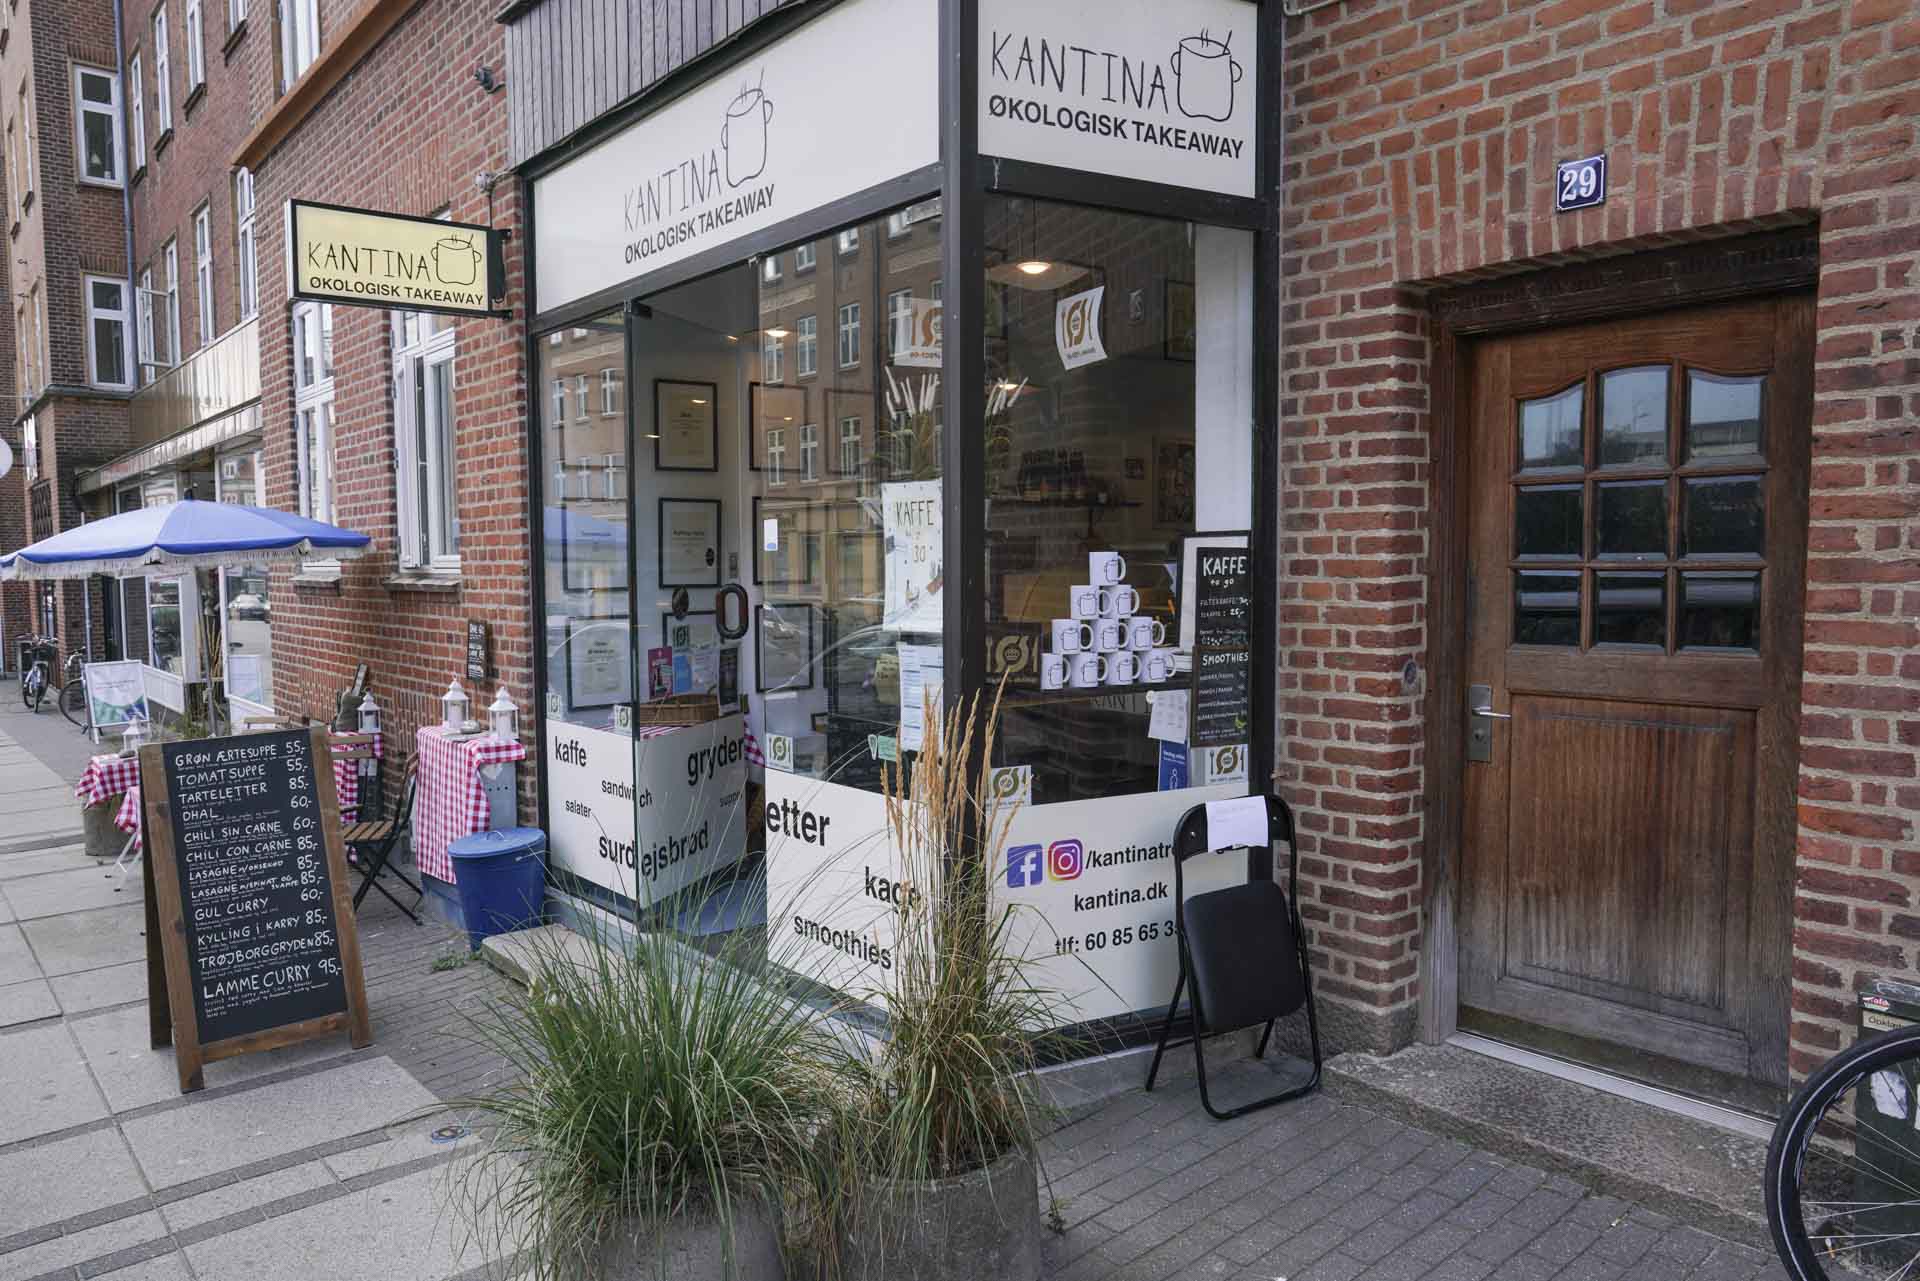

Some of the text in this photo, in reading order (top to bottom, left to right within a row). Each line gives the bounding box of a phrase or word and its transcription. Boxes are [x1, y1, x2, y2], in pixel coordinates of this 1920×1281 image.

[992, 31, 1168, 114] KANTINA
[988, 94, 1244, 160] ØKOLOGISK TAKEAWAY
[624, 149, 722, 233] KANTINA
[1561, 166, 1597, 202] 29
[624, 183, 775, 264] ØKOLOGISK TAKEAWAY
[308, 241, 431, 282] KANTINA
[404, 286, 484, 306] TAKEAWAY
[896, 499, 935, 528] KAFFE
[913, 544, 927, 564] 30
[1203, 555, 1248, 577] KAFFE
[1202, 651, 1249, 667] SMOOTHIES
[175, 753, 211, 767] GRØN
[216, 744, 278, 762] ÆRTESUPPE
[554, 735, 745, 787] kaffe gryder
[178, 782, 268, 804] TARTELETTER
[182, 808, 219, 822] DHAL
[565, 799, 592, 818] salater
[766, 797, 830, 847] etter
[184, 828, 215, 843] CHILI
[221, 827, 240, 838] SIN
[245, 821, 281, 835] CARNE
[186, 847, 220, 863] CHILI
[226, 845, 250, 857] CON
[254, 839, 293, 854] CARNE
[189, 864, 238, 881] LASAGNE
[191, 883, 239, 899] LASAGNE
[1074, 881, 1169, 912] kantina.dk
[195, 907, 222, 921] GUL
[226, 897, 269, 915] CURRY
[198, 926, 251, 946] KYLLING
[266, 916, 300, 931] KARRY
[793, 915, 892, 970] smoothies
[1055, 936, 1079, 954] tlf:
[1085, 931, 1107, 951] 60
[1112, 927, 1133, 947] 85
[1138, 923, 1159, 942] 65
[198, 937, 314, 969] TRØJBORGGRYDEN
[203, 974, 260, 999] LAMME
[263, 963, 312, 987] CURRY
